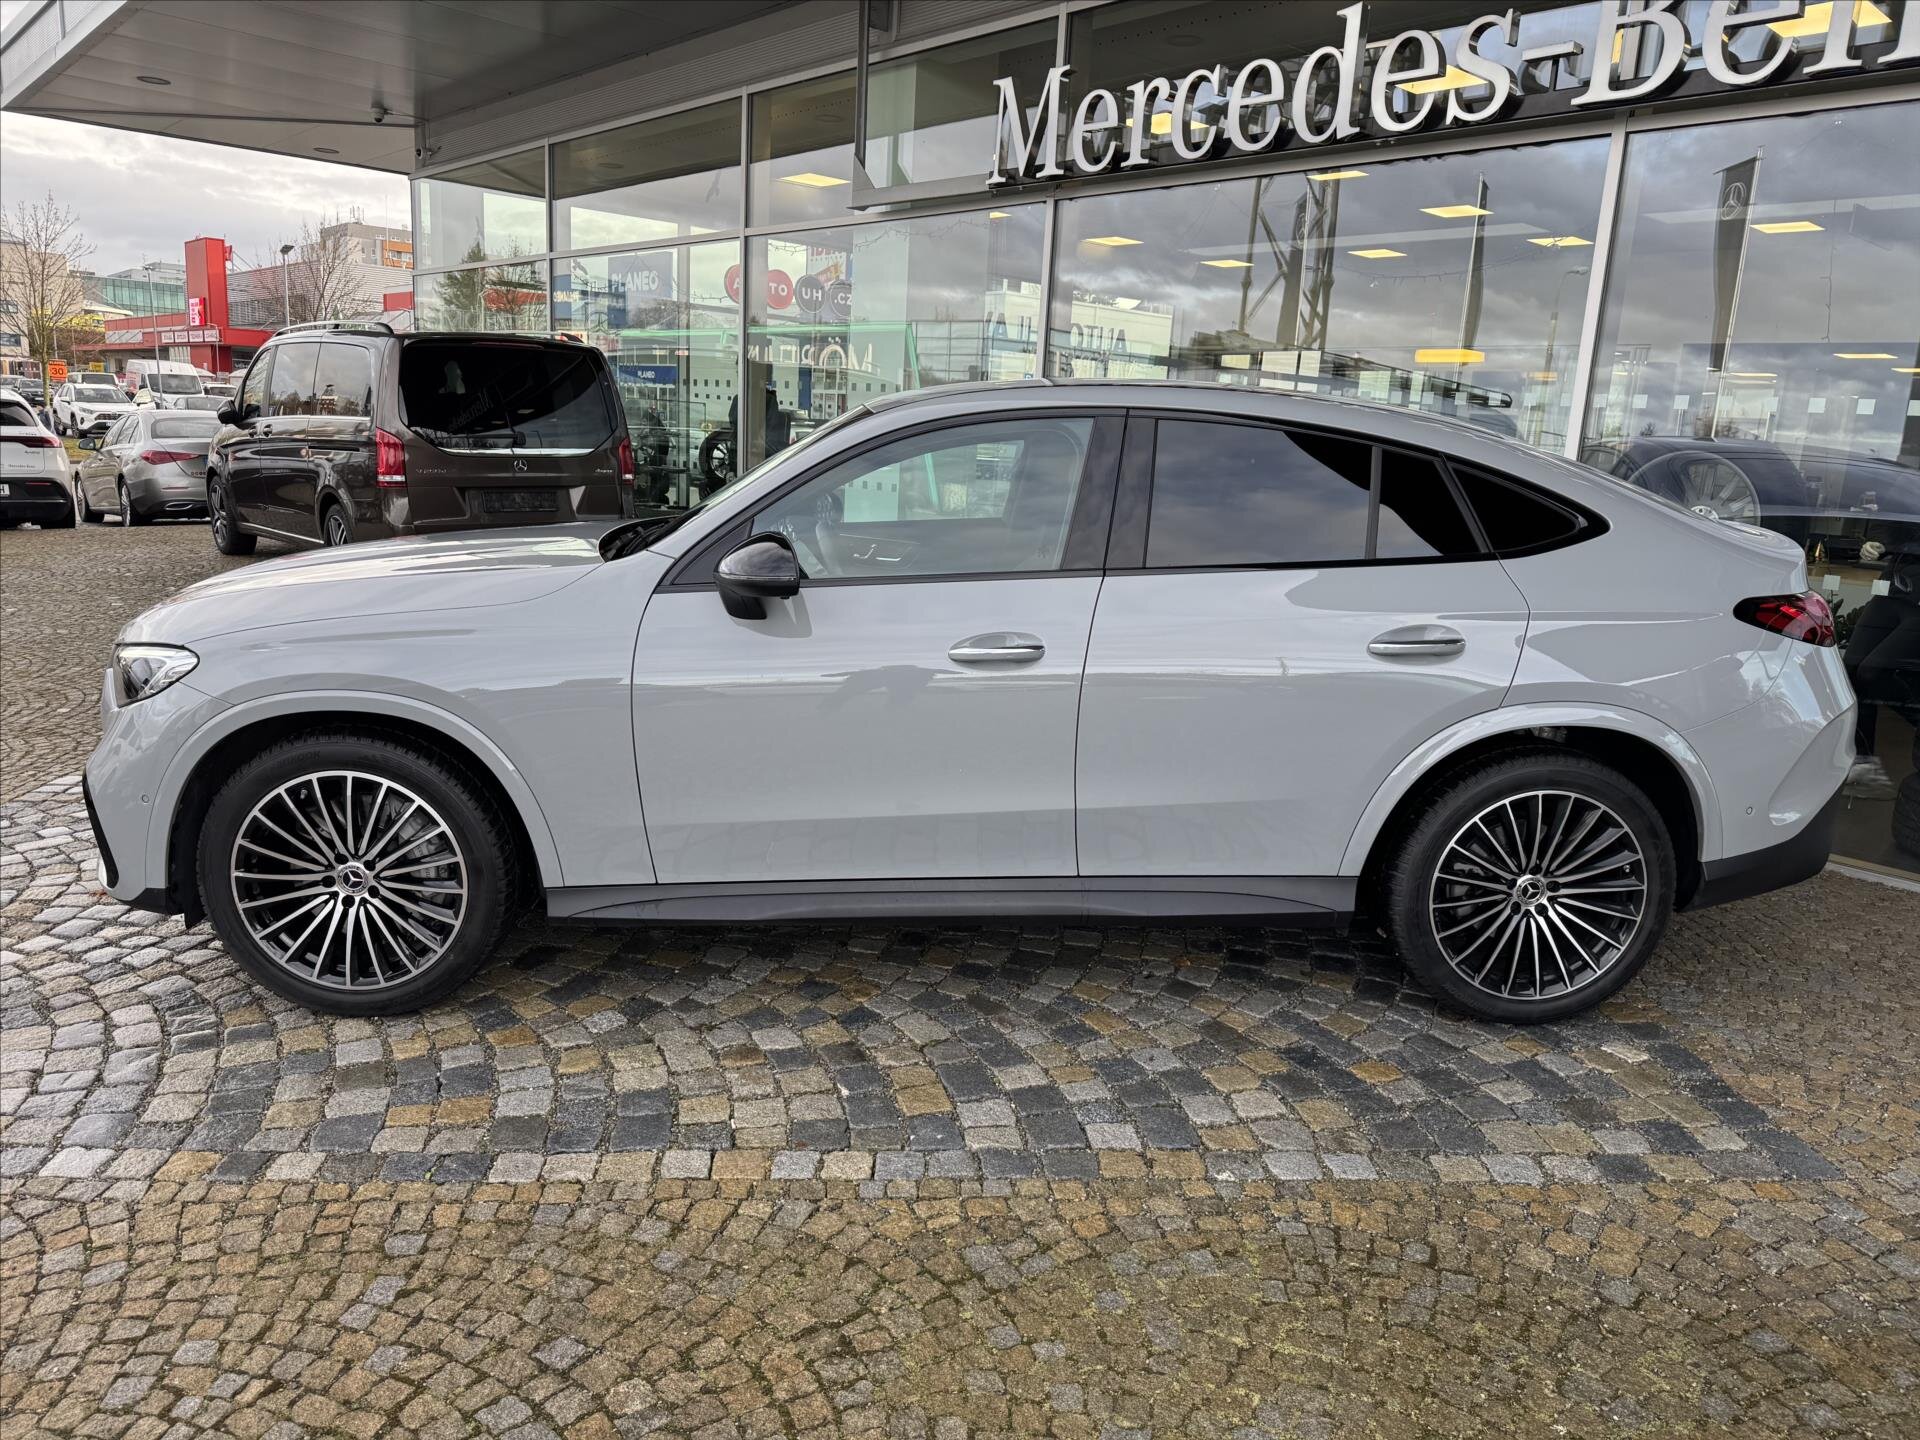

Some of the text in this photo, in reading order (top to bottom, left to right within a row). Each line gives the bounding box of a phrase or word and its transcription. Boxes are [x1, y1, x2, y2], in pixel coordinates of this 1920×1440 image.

[611, 270, 659, 292] PLANEO
[733, 278, 788, 297] ATO
[802, 286, 822, 301] UH
